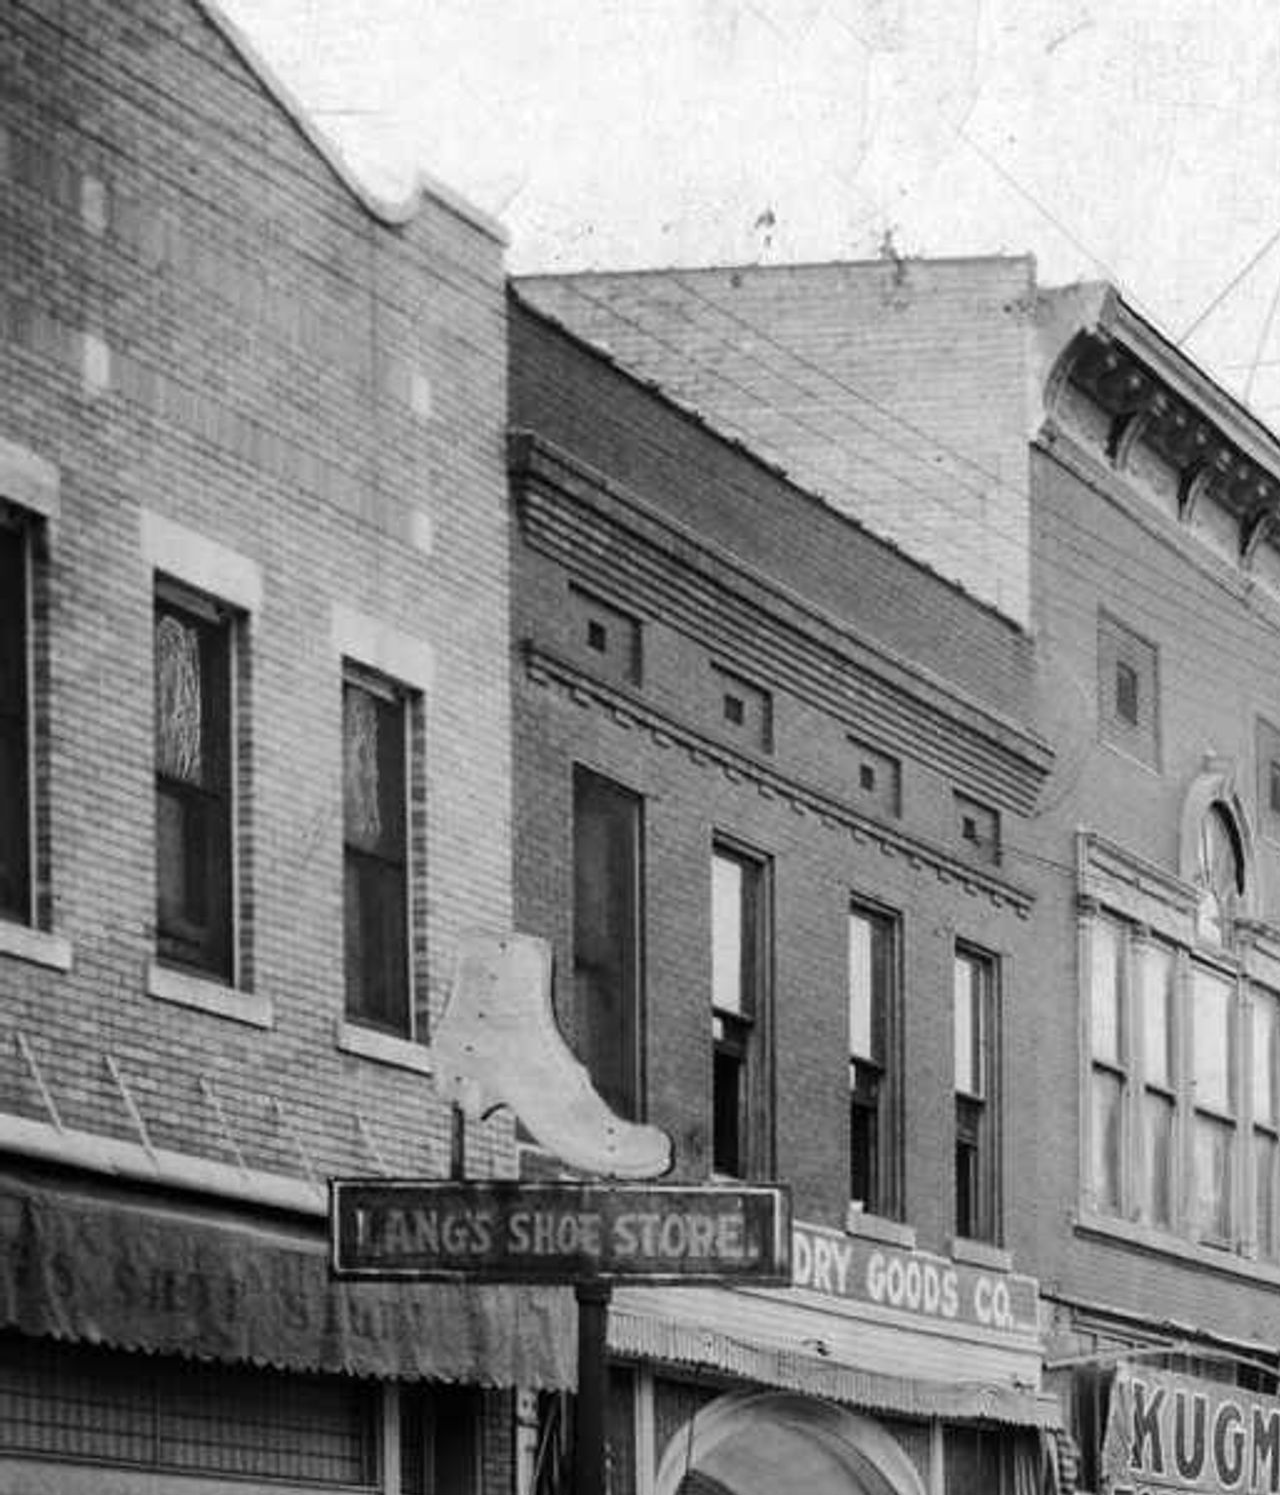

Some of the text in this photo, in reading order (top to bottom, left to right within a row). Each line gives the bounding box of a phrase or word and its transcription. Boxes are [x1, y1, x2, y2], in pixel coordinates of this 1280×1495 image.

[508, 1212, 601, 1256] SHOE
[793, 1231, 852, 1294] DRY
[866, 1252, 959, 1318] GOODS
